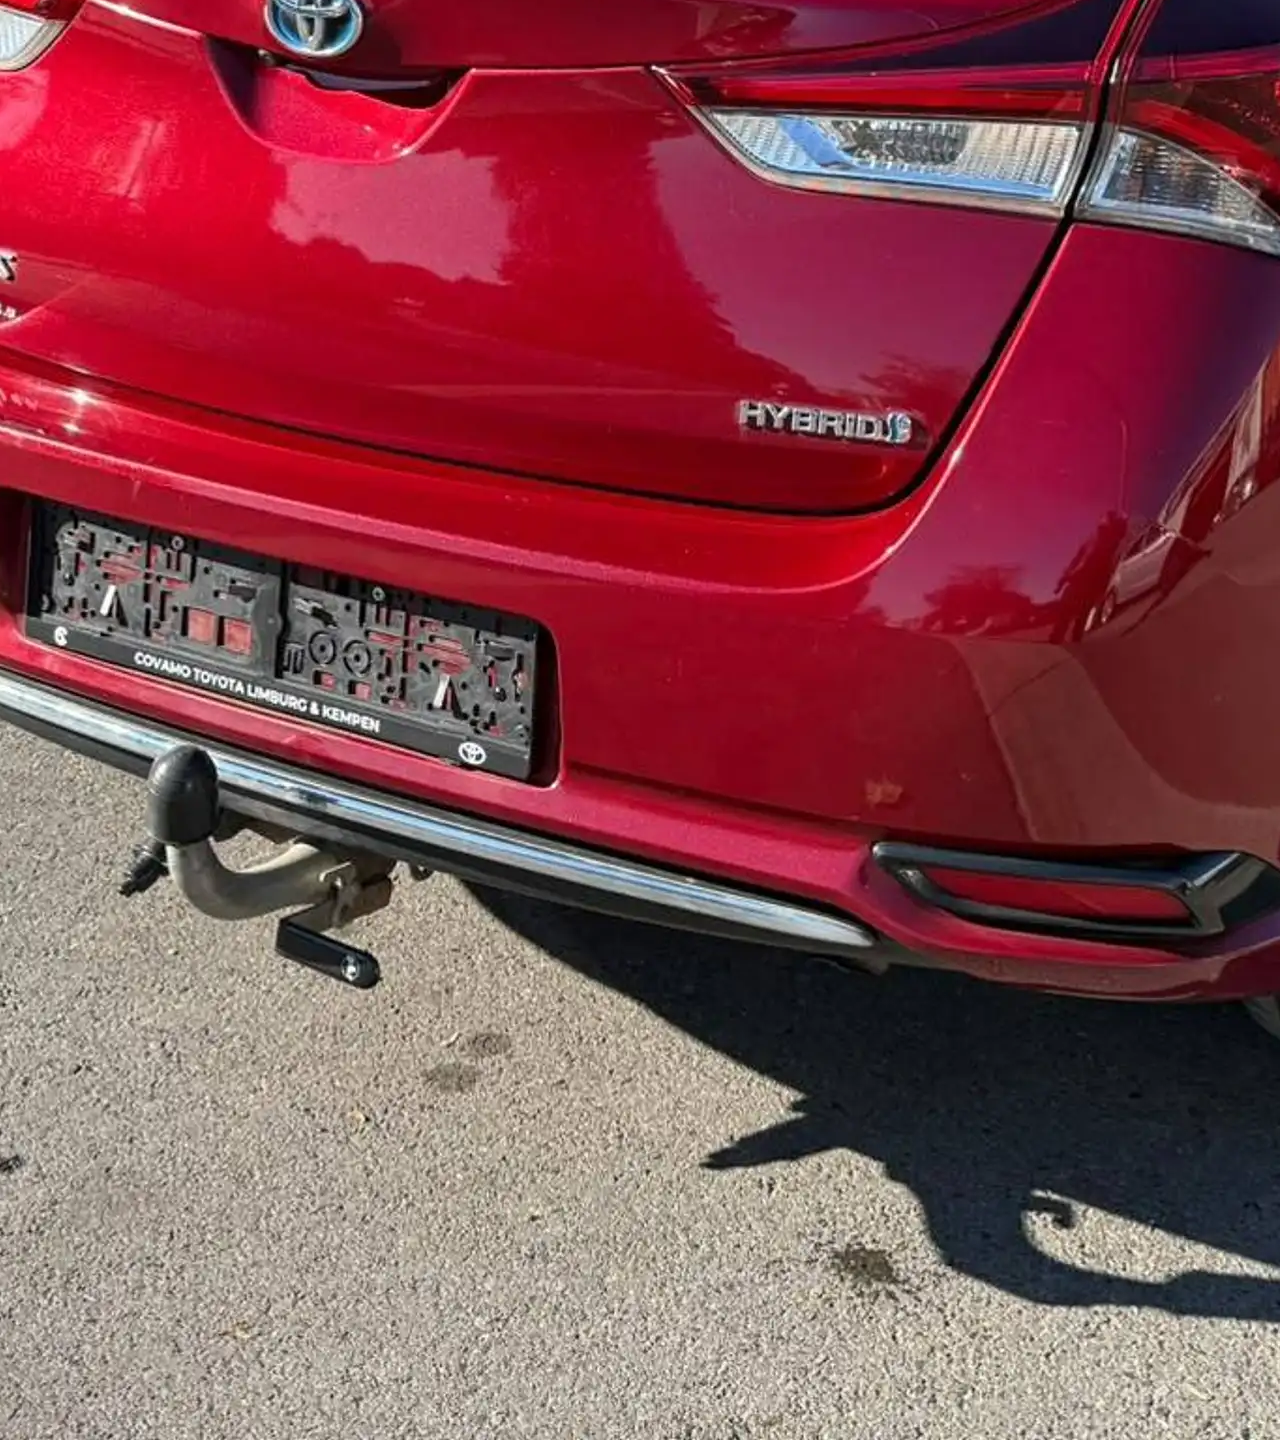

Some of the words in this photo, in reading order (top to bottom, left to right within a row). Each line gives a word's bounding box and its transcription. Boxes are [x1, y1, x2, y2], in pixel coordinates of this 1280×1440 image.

[738, 399, 884, 442] HYBRID
[133, 651, 192, 678] COVAMO
[193, 667, 245, 695] TOYOTA
[247, 683, 308, 713] LIMBURG
[309, 701, 320, 716] &
[322, 705, 381, 734] KEMPEN
